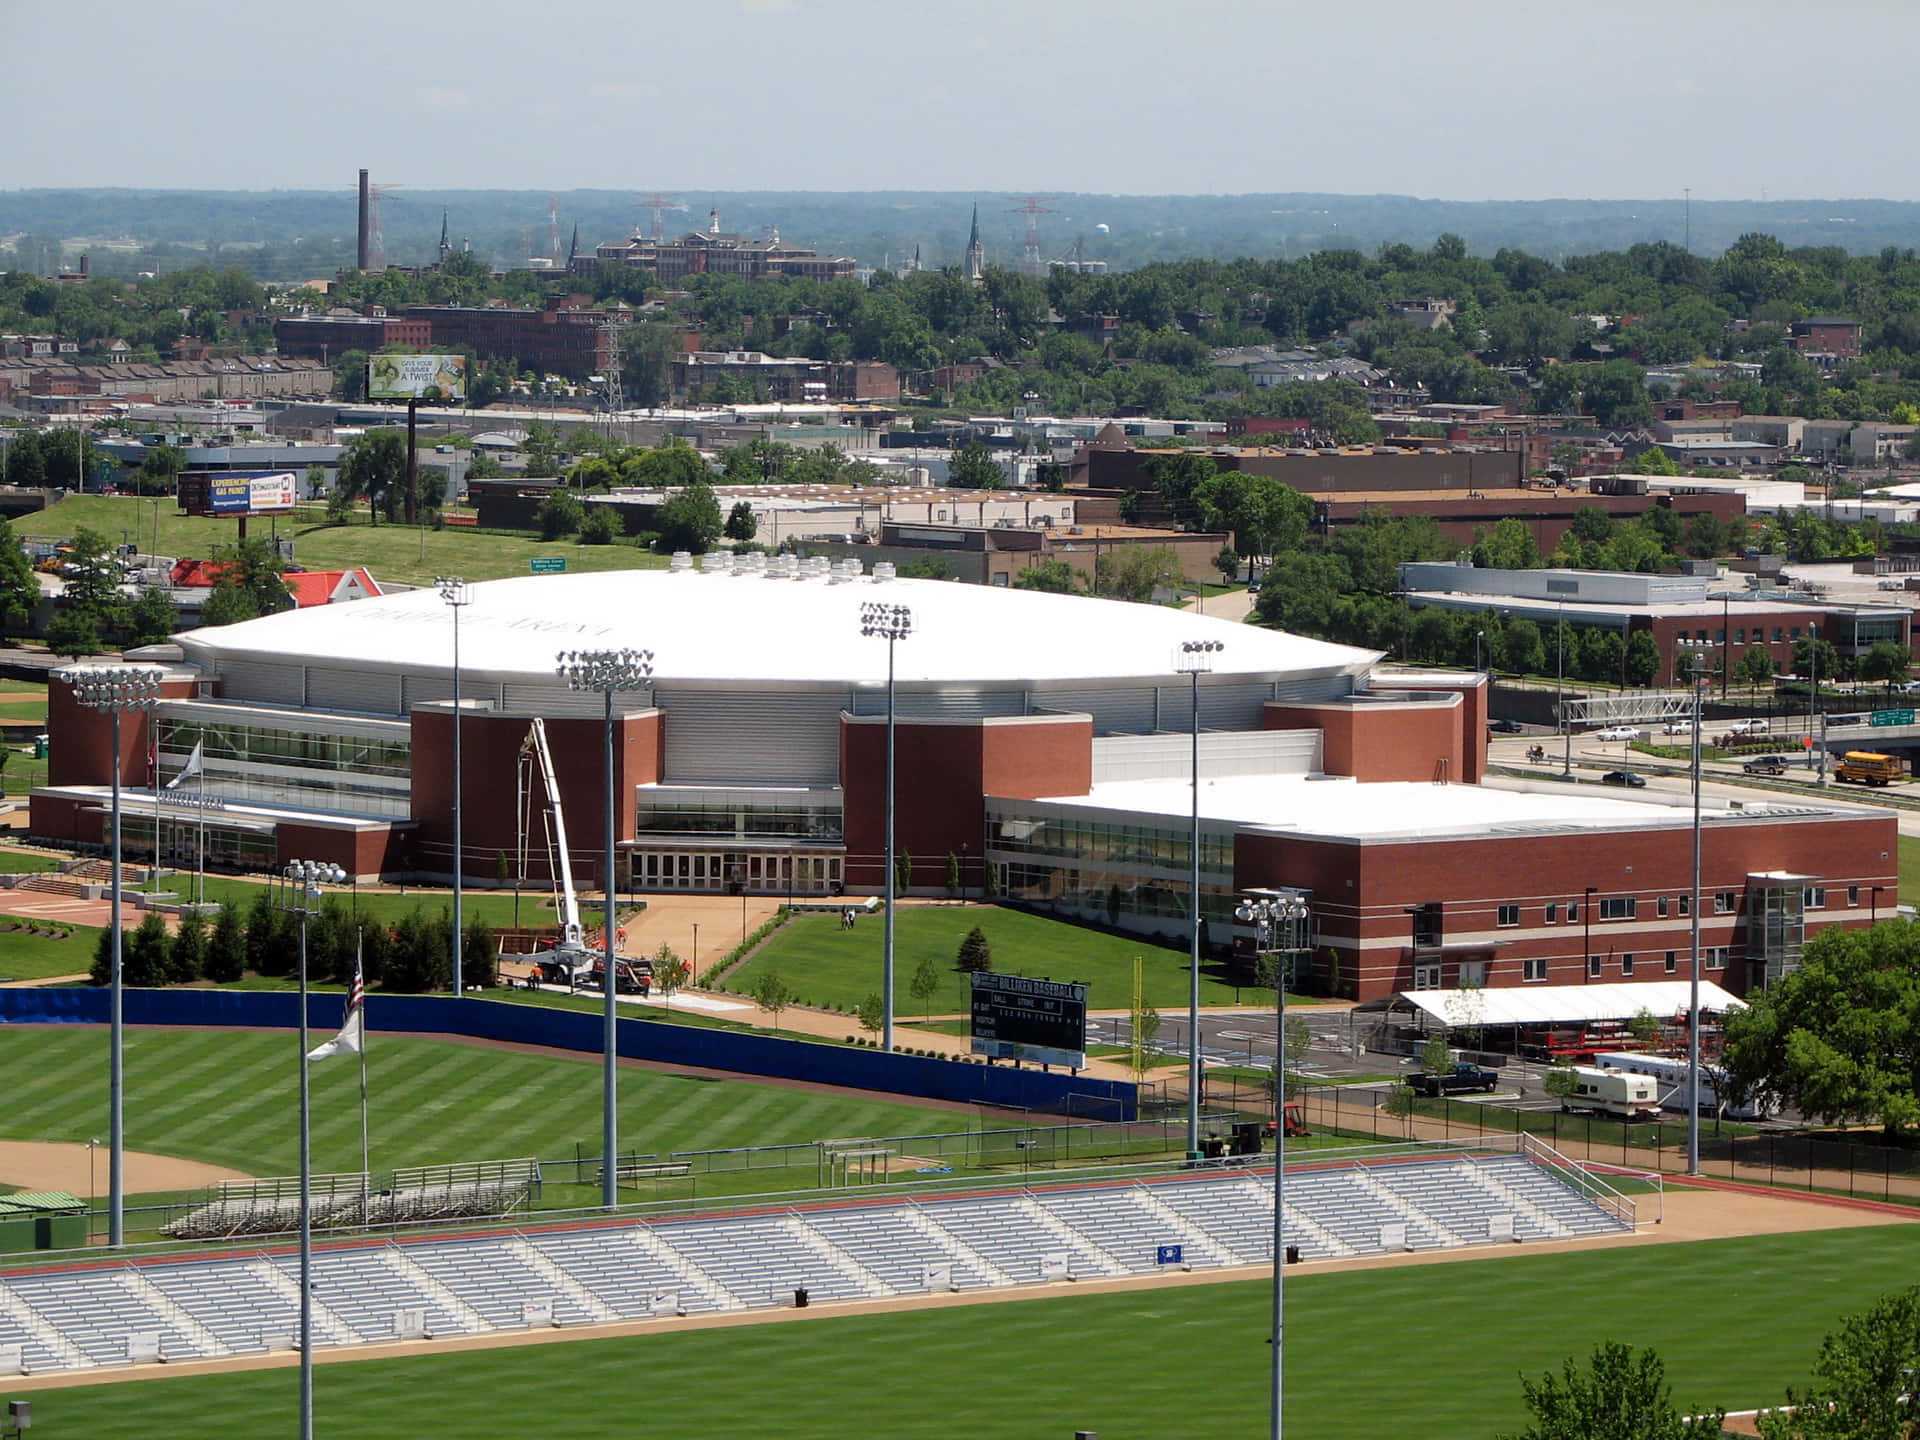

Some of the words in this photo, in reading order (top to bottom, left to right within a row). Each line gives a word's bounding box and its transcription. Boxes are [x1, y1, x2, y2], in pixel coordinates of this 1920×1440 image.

[409, 373, 433, 381] TWIST
[1000, 977, 1032, 993] BILLIKEN
[1033, 982, 1073, 998] BASEBALL
